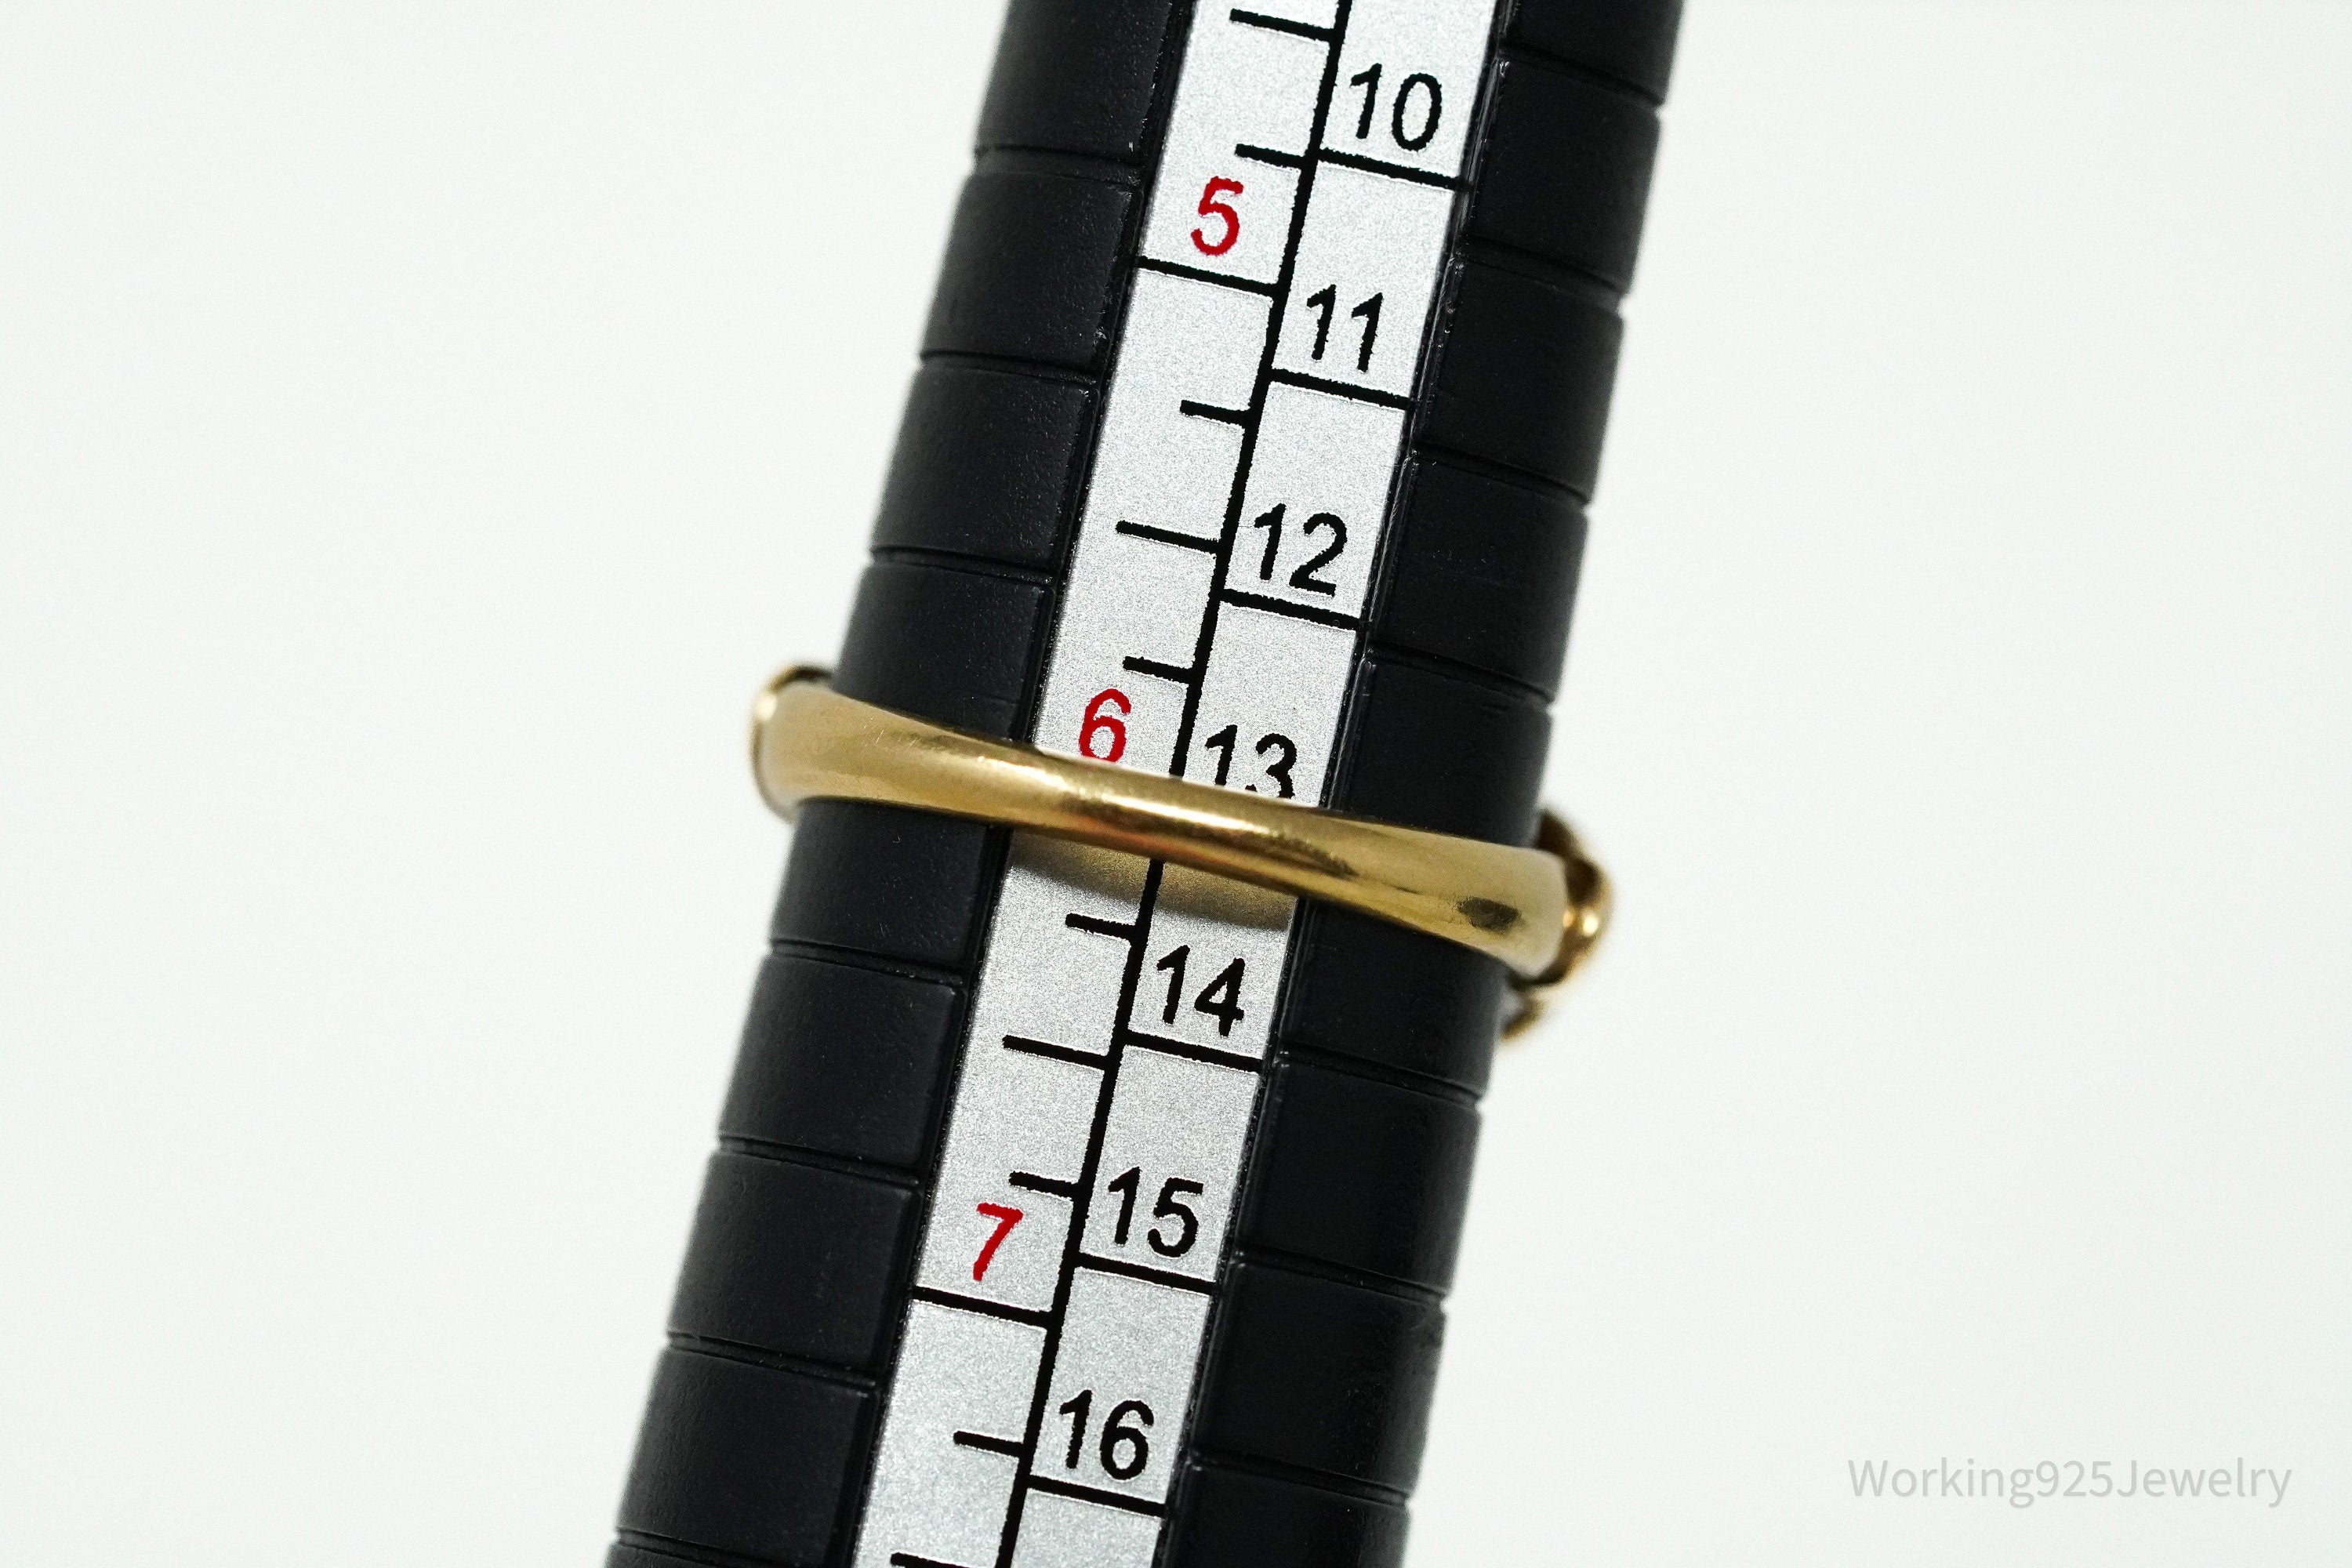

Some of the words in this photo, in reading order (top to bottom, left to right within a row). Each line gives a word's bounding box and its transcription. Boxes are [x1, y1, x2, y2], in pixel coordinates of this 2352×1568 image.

[1350, 64, 1443, 152] 10
[1191, 176, 1244, 256] 5
[1307, 285, 1384, 372] 11
[1254, 503, 1348, 597] 12
[1079, 688, 1131, 764] 6
[1205, 724, 1298, 799] 13
[1156, 945, 1246, 1037] 14
[973, 1203, 1023, 1281] 7
[1108, 1167, 1204, 1258] 15
[1059, 1389, 1155, 1480] 16
